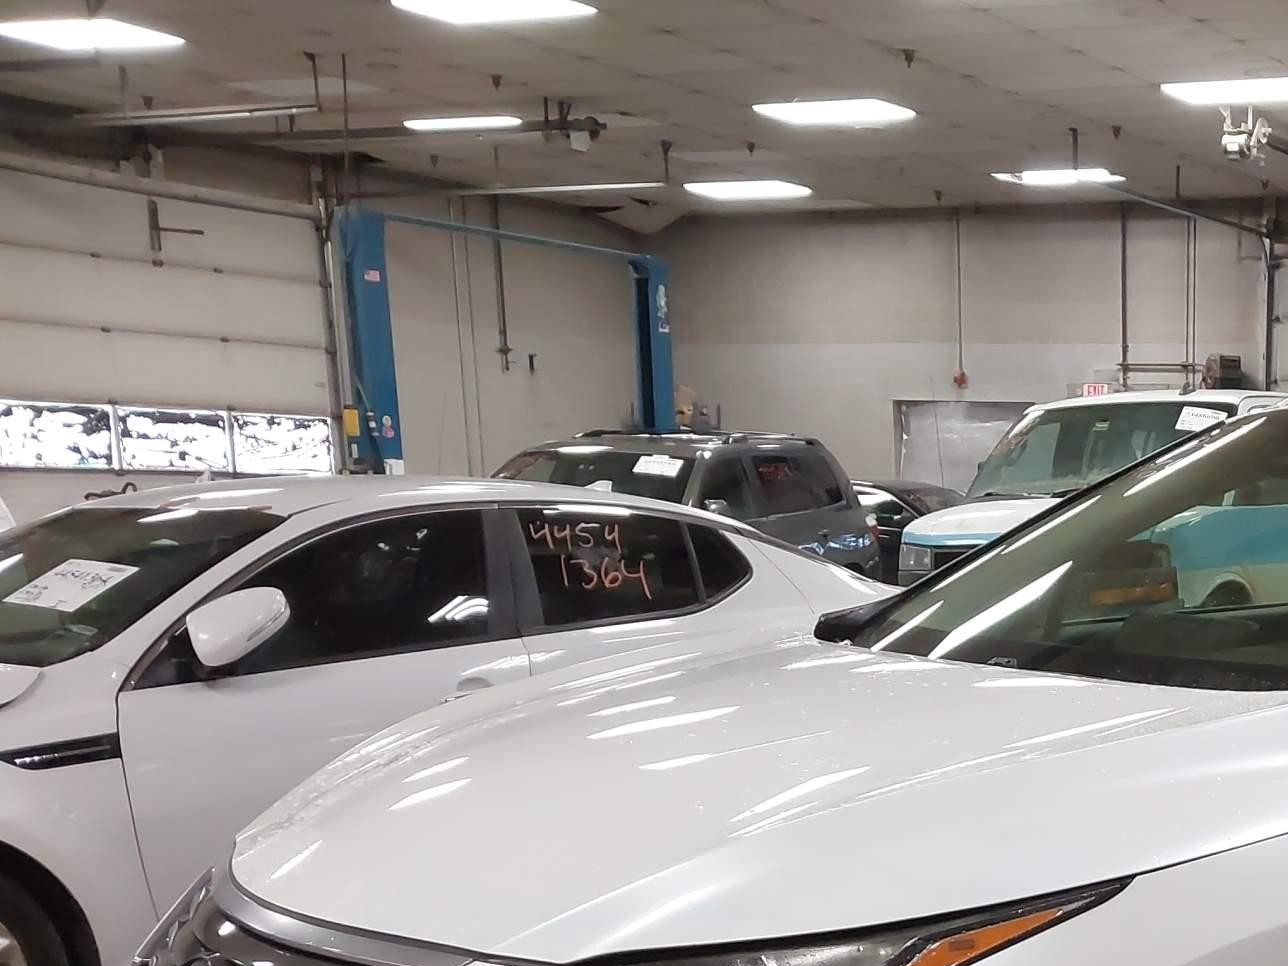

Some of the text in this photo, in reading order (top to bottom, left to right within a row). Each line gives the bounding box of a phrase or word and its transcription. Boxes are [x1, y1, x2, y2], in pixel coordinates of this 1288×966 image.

[1087, 385, 1105, 397] EXIT
[529, 522, 622, 554] 4454
[561, 554, 652, 600] 1364
